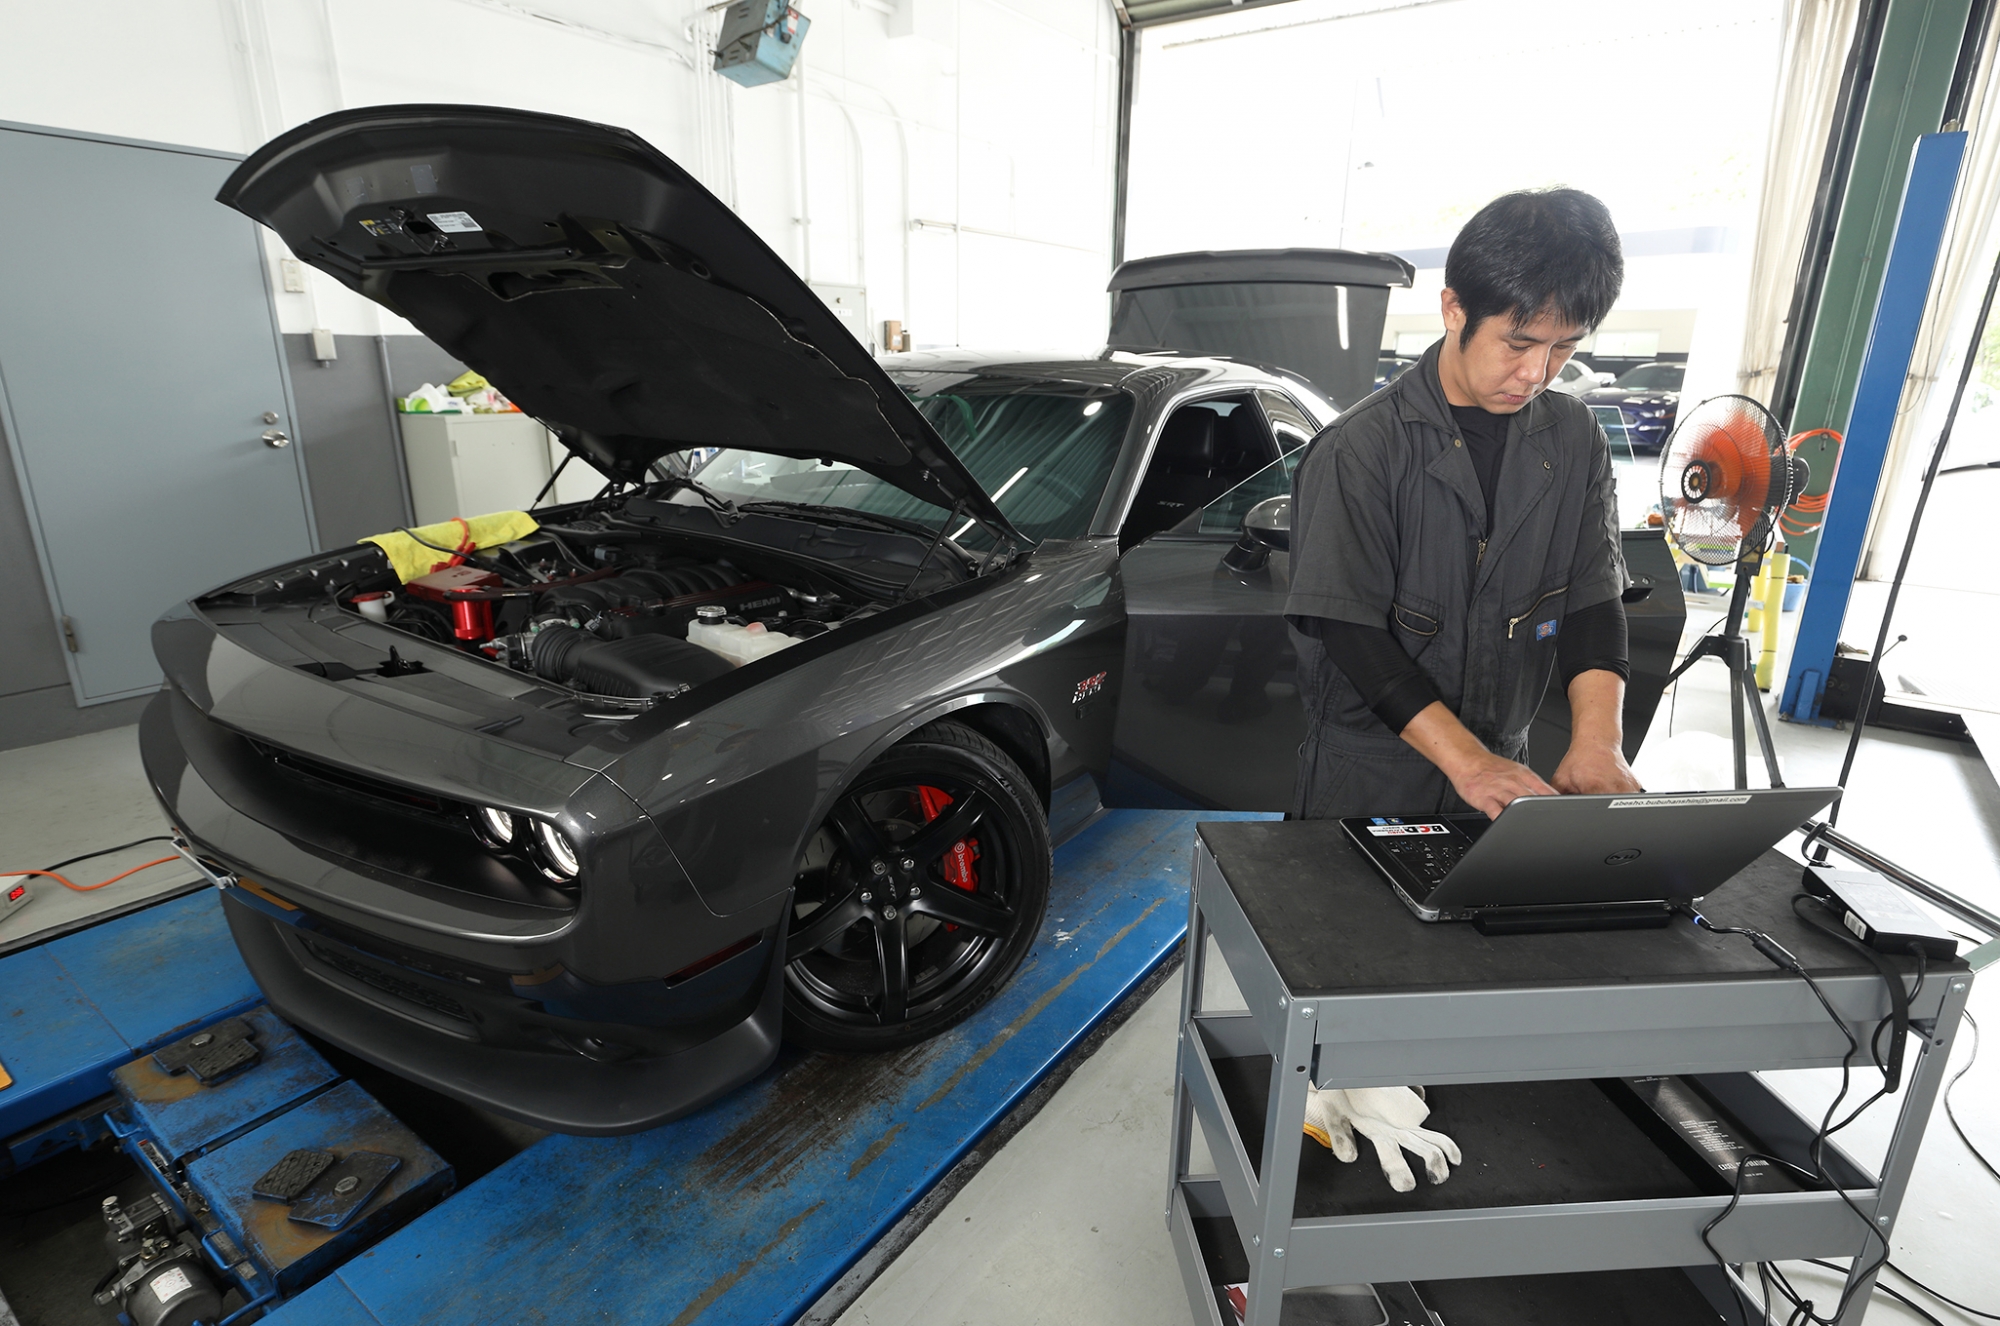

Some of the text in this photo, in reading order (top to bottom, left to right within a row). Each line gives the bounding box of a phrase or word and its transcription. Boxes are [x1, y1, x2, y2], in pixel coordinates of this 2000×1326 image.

[740, 597, 780, 611] HEMI
[1613, 797, 1747, 806] abesho.bubuhanshin@gmail.com
[957, 853, 968, 883] brembo
